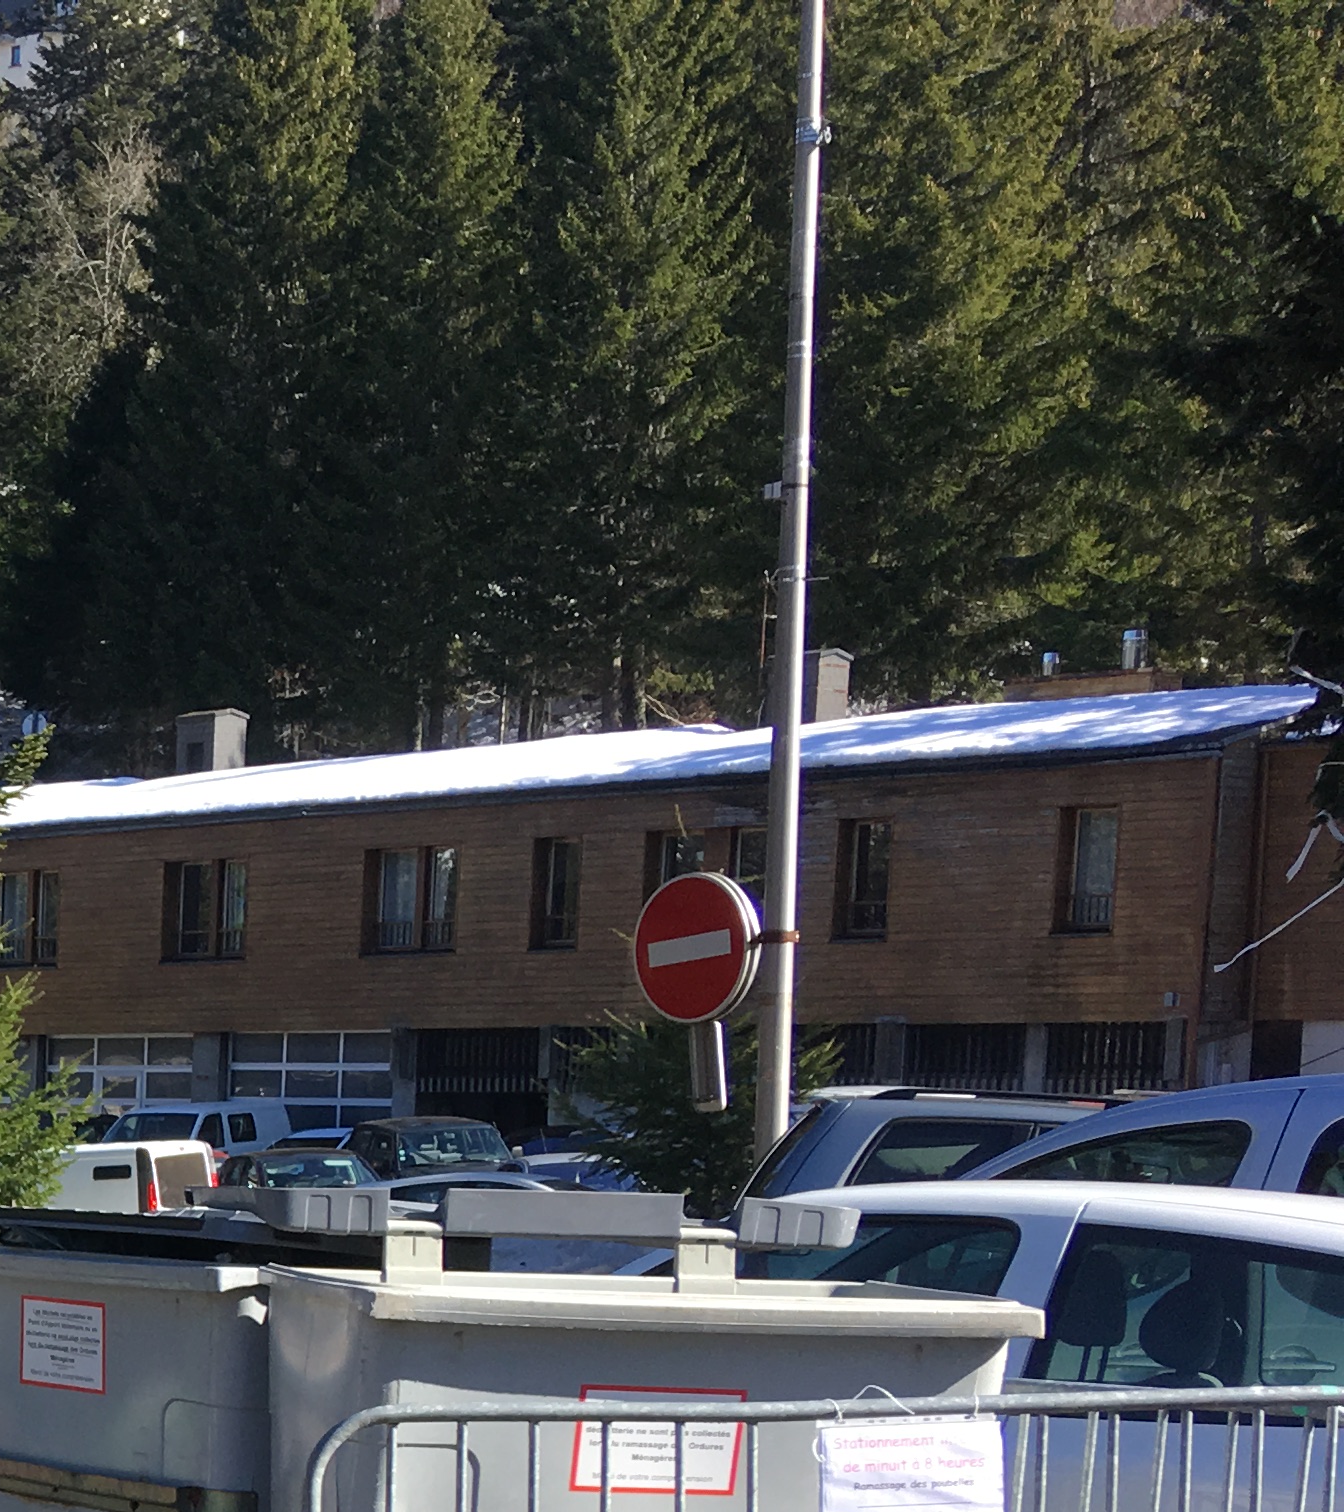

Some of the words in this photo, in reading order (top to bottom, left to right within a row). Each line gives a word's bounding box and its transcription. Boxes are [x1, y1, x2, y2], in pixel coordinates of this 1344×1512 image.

[670, 1429, 689, 1438] ps
[688, 1442, 724, 1451] Ordures
[833, 1436, 935, 1450] Stationnement
[843, 1459, 861, 1473] de
[864, 1459, 907, 1472] minuit
[913, 1457, 921, 1470] à
[924, 1457, 933, 1470] 8
[938, 1455, 985, 1469] heures
[853, 1481, 906, 1492] Ramassage
[909, 1479, 927, 1489] des
[930, 1478, 975, 1490] poubelles
